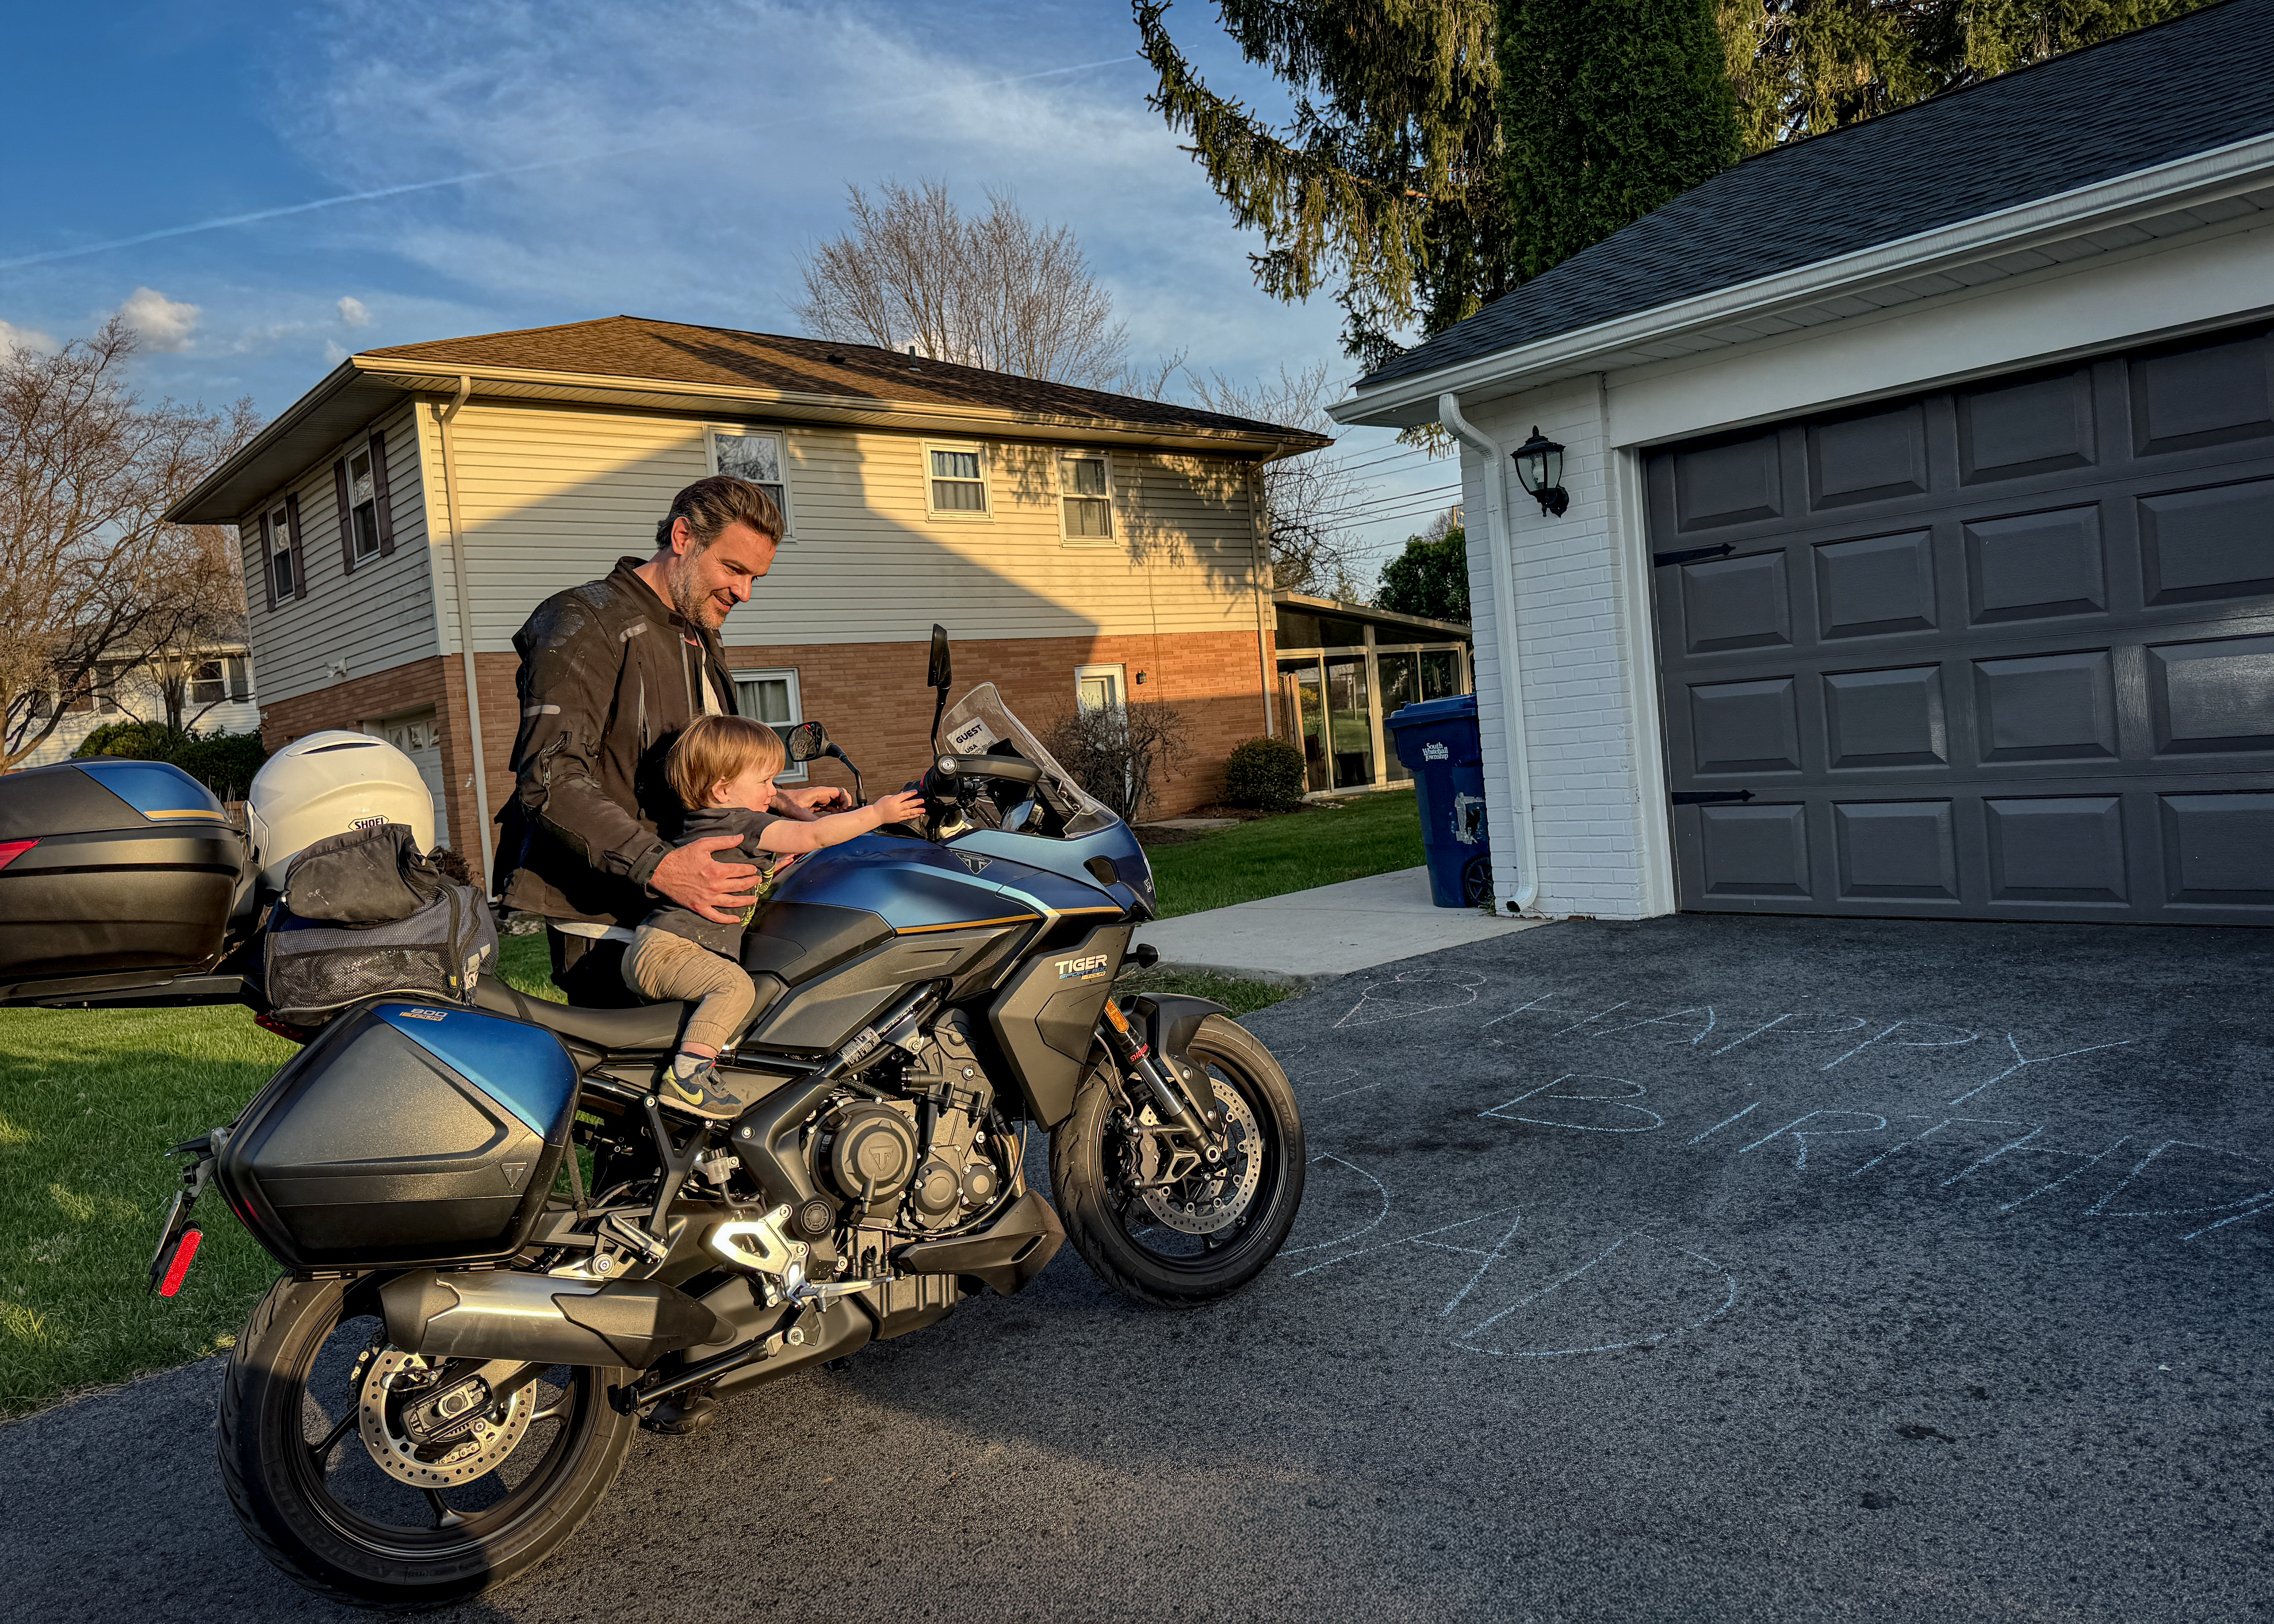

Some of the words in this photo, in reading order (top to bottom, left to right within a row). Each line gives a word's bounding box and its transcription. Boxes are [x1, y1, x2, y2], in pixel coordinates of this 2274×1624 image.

[956, 724, 982, 744] GUEST
[965, 744, 978, 753] USA
[1422, 747, 1448, 756] Whitehall
[355, 817, 383, 830] SHOEI
[1055, 954, 1108, 975] TIGER
[1059, 970, 1090, 979] SPORT
[411, 1008, 448, 1017] 800
[1130, 1043, 1149, 1062] SHOWA
[1480, 992, 2130, 1105] HAPPY
[1280, 1104, 1296, 1159] MICHELIN
[1477, 1074, 2274, 1240] BIRTHD
[1273, 1152, 1736, 1356] DAD
